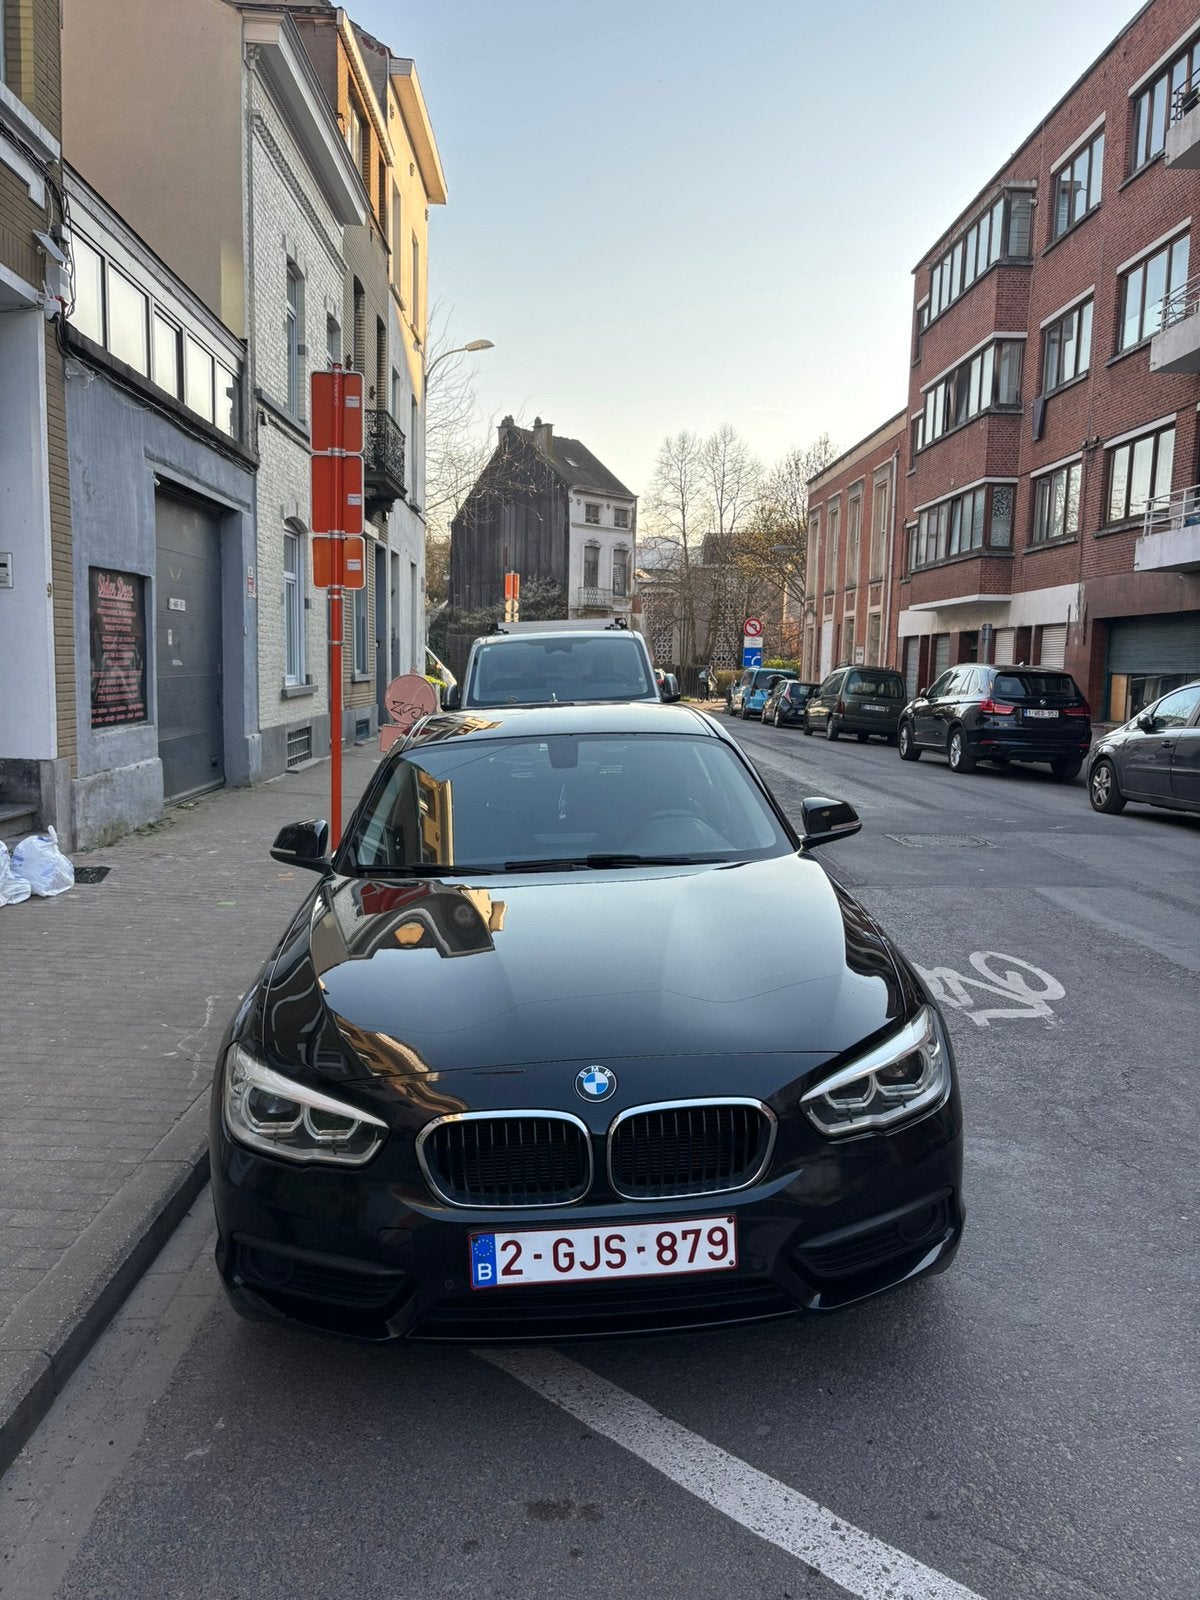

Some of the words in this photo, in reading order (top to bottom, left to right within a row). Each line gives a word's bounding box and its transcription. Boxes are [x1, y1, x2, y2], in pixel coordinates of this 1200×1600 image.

[579, 1066, 614, 1078] BMW
[477, 1262, 492, 1281] B
[500, 1226, 729, 1276] 2-GJS-879
